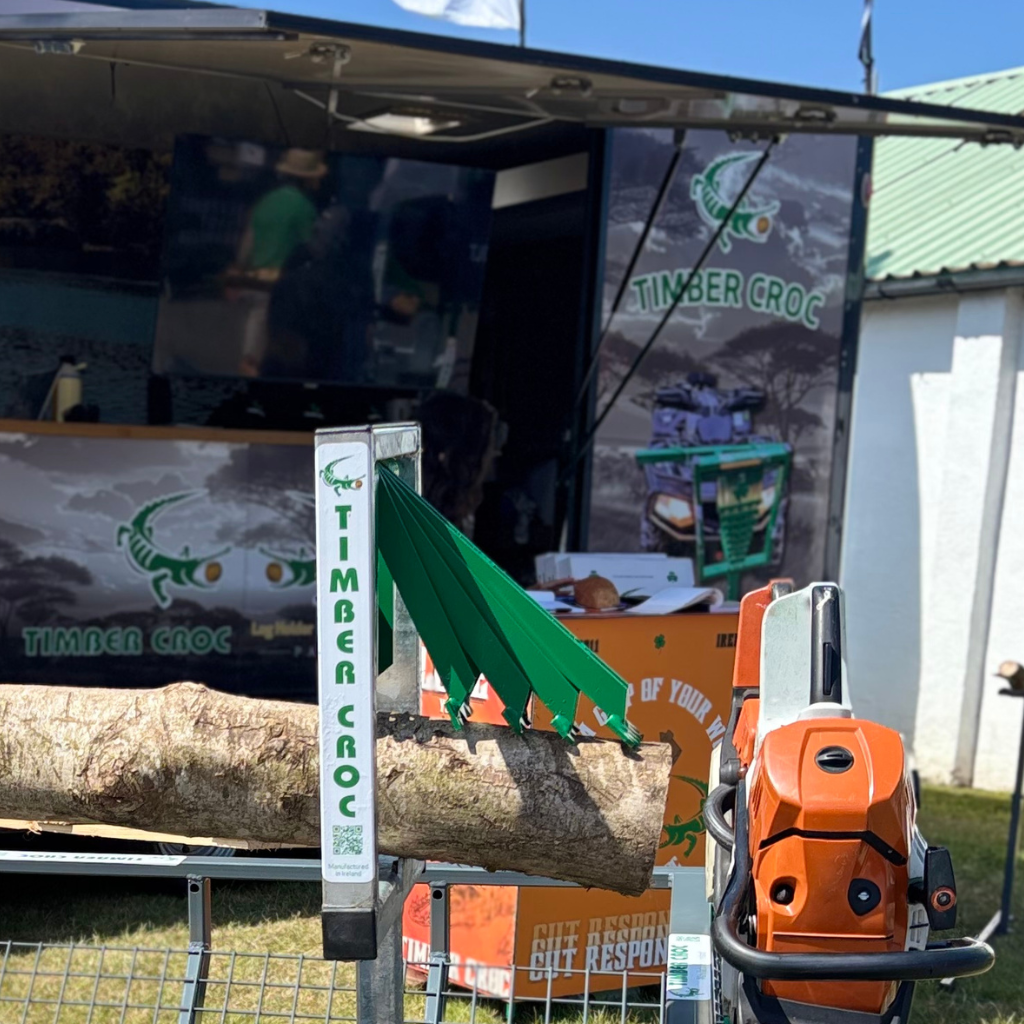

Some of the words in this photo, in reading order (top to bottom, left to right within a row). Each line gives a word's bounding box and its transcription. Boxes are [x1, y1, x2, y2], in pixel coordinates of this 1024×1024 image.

[631, 268, 743, 312] TIMBER
[748, 273, 824, 328] CROC
[330, 505, 359, 685] TIMBER
[23, 626, 142, 656] TIMBER
[151, 626, 232, 654] CROC
[641, 677, 664, 702] OF
[668, 679, 713, 725] YOUR
[333, 705, 360, 818] CROC
[529, 948, 578, 982] CUT
[585, 936, 668, 971] RESPON
